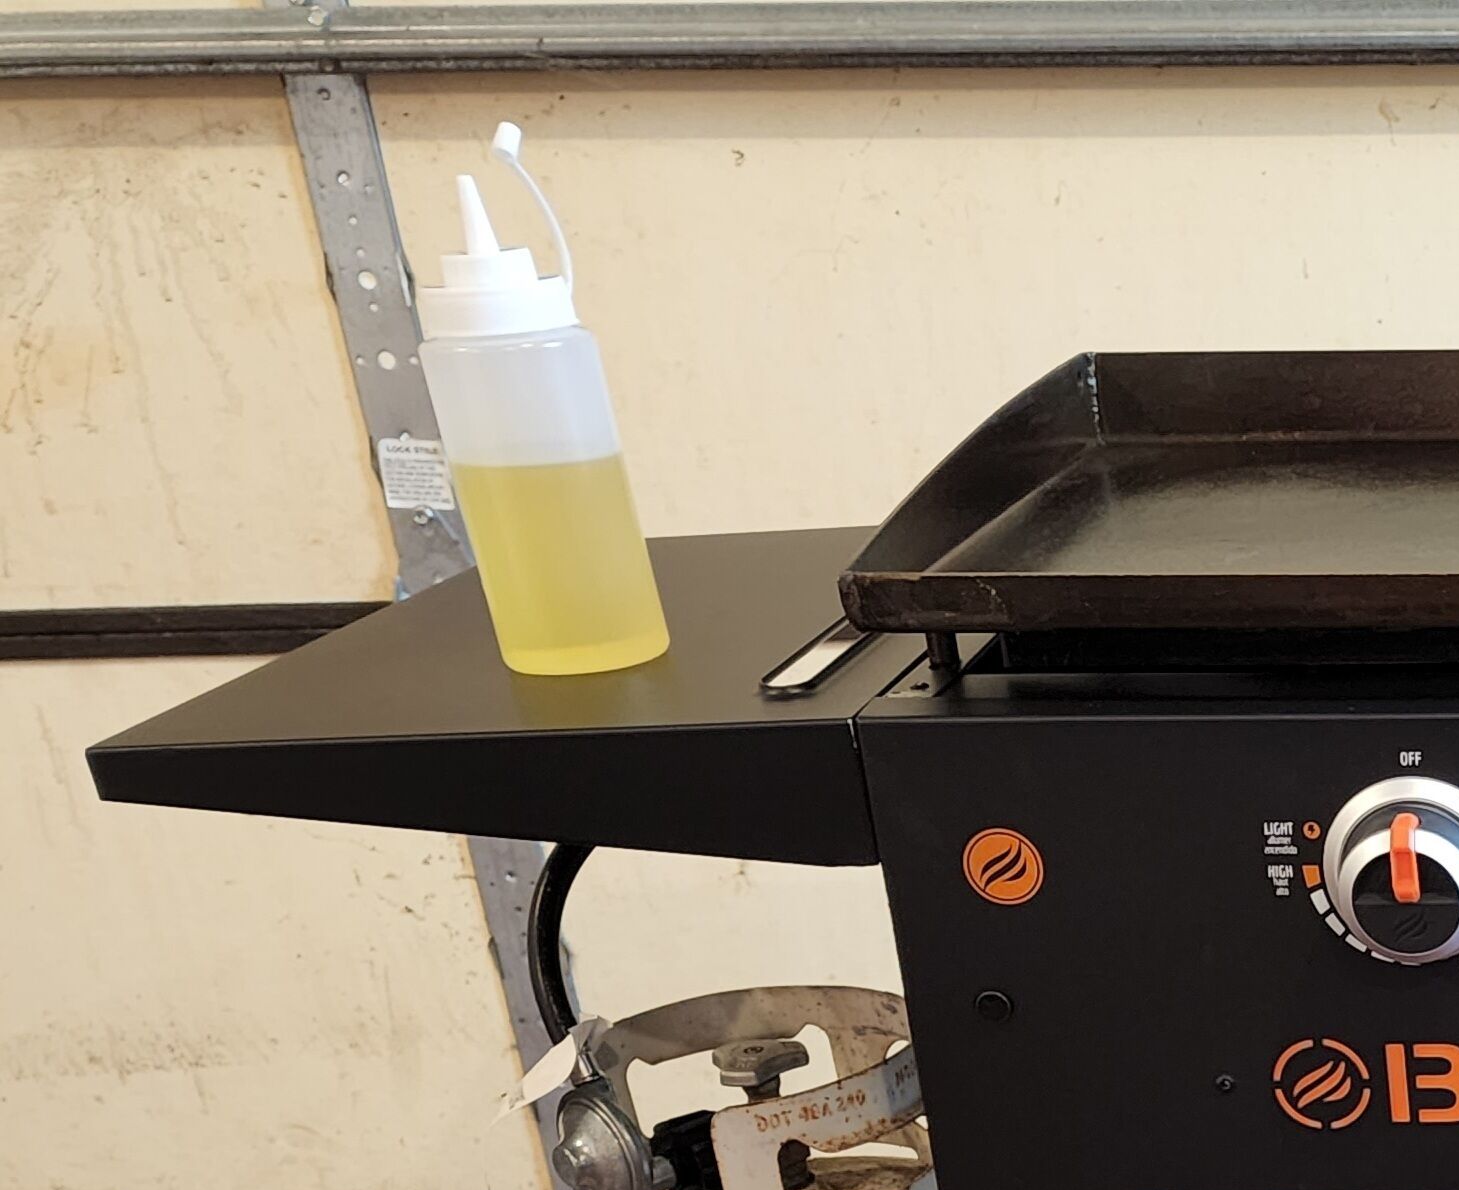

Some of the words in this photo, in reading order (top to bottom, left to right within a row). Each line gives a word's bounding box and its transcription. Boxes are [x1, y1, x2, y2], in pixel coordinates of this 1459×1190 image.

[1399, 751, 1422, 766] OFF
[1264, 822, 1293, 836] LIGHT
[1268, 864, 1293, 878] HIGH
